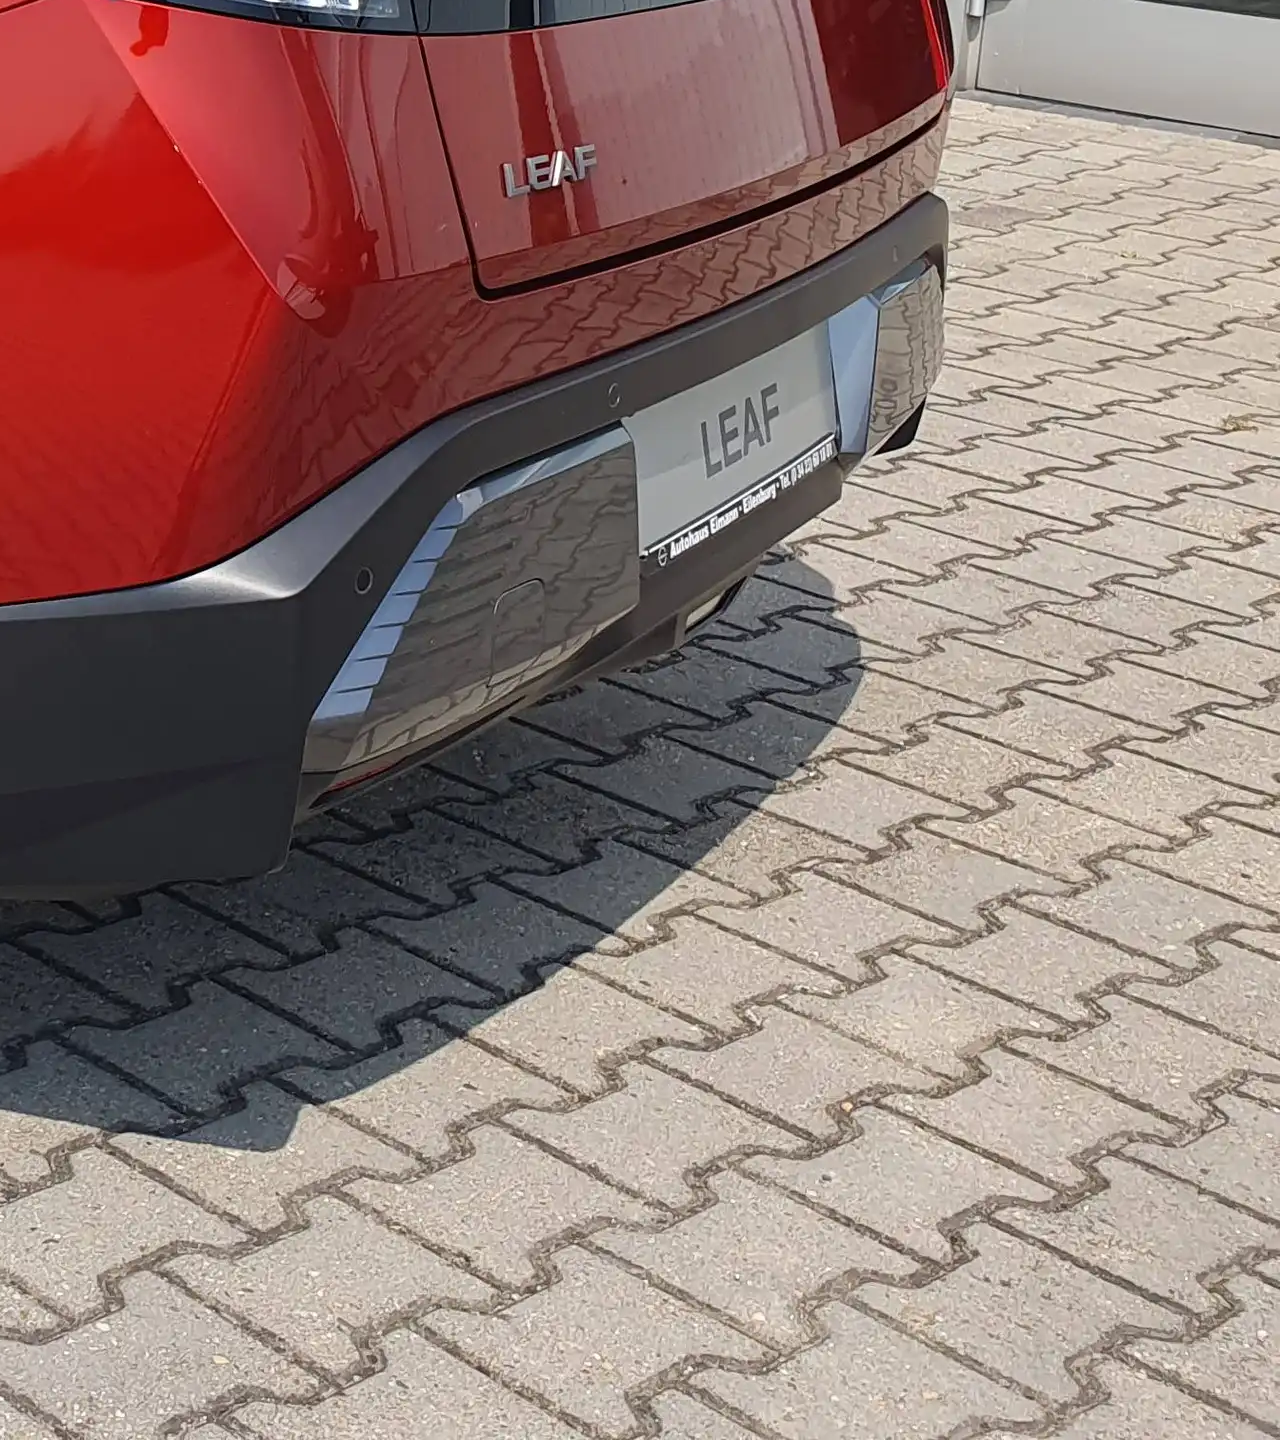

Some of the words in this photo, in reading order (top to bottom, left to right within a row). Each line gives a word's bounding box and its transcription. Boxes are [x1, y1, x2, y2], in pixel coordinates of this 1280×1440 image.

[502, 144, 597, 197] LEAF
[701, 382, 779, 479] LEAF
[670, 525, 709, 559] Autohaus
[710, 506, 739, 535] Eimann
[742, 483, 777, 515] Eilenburg
